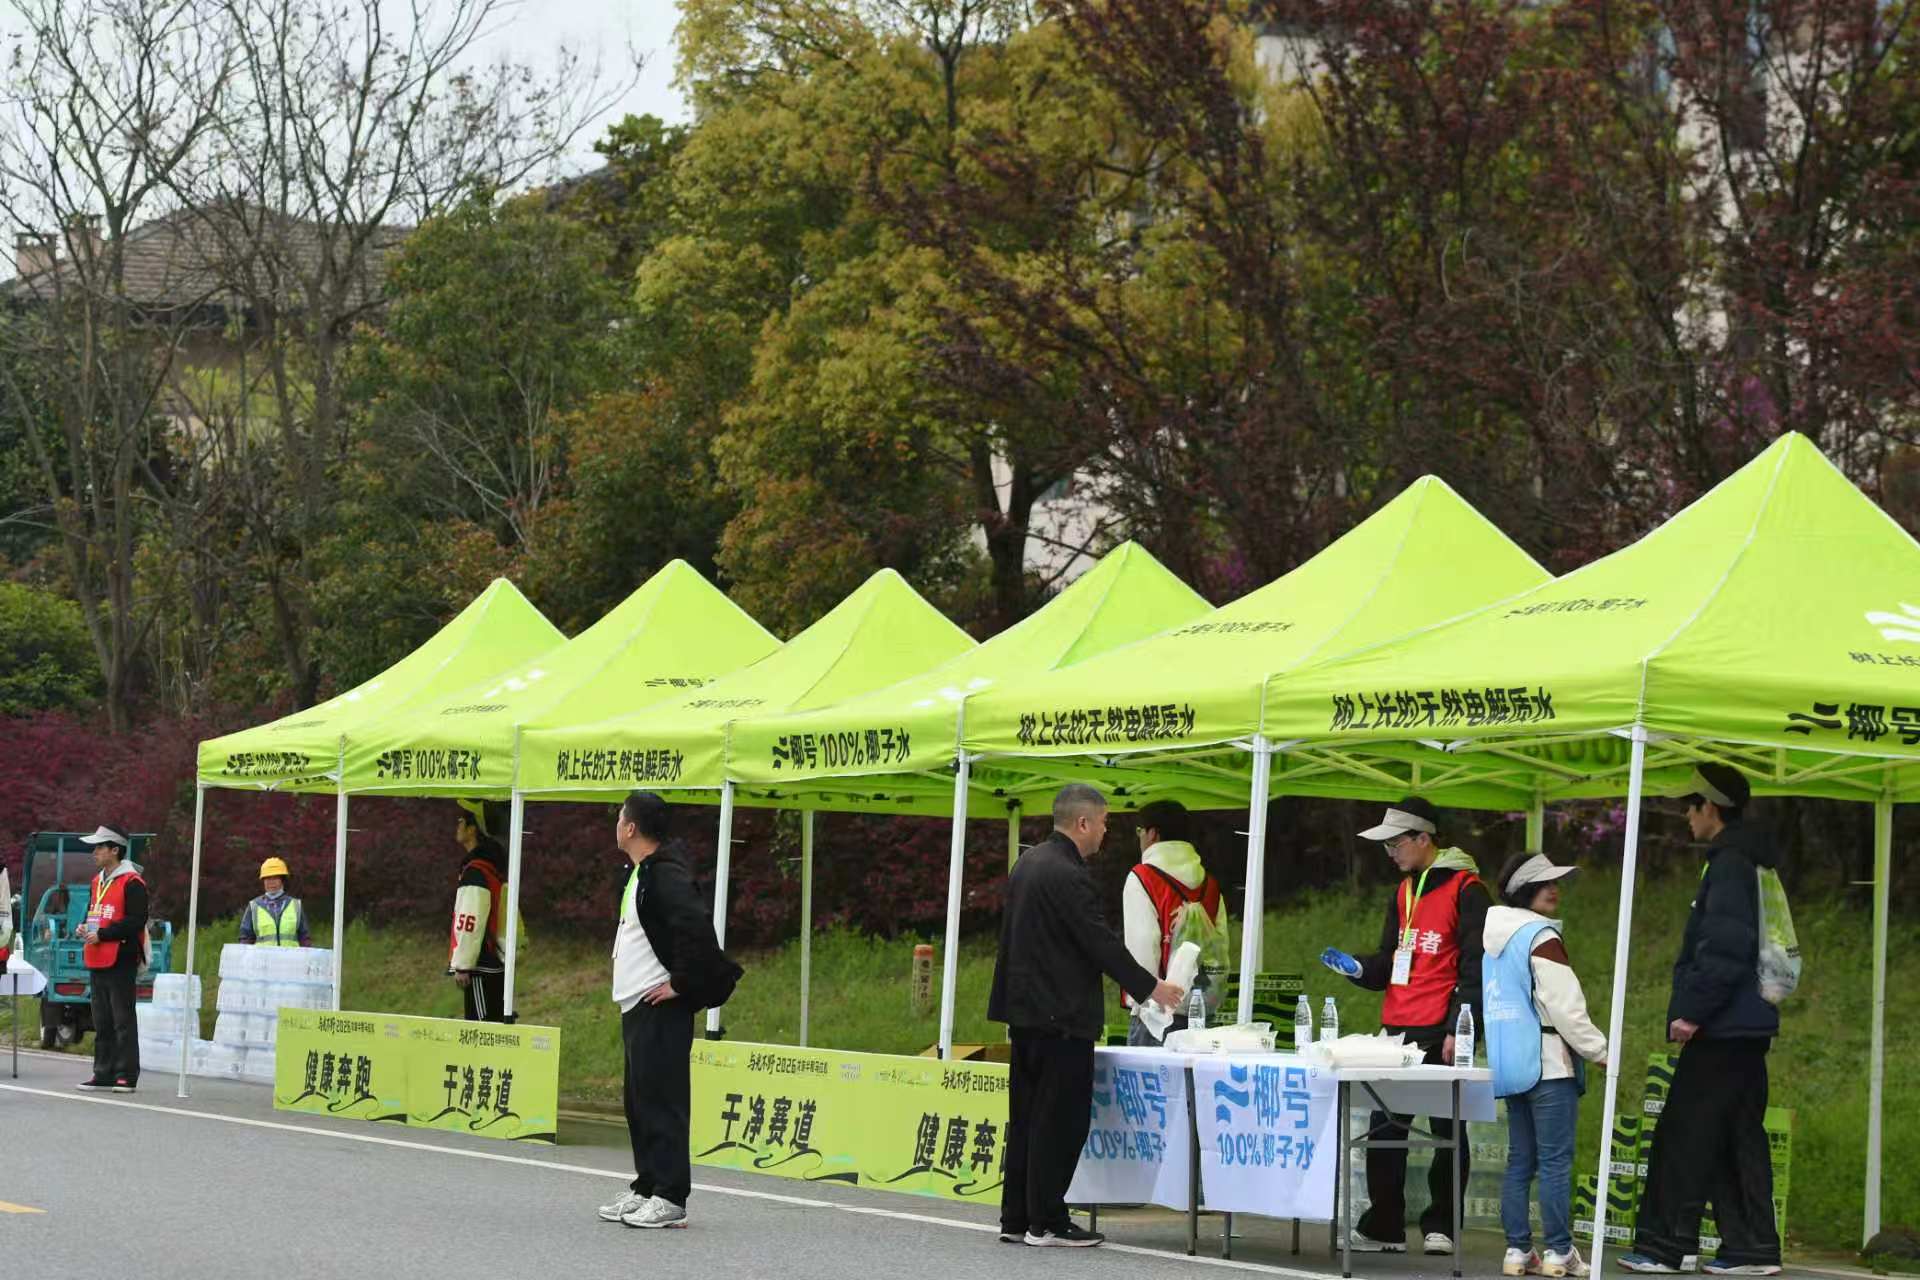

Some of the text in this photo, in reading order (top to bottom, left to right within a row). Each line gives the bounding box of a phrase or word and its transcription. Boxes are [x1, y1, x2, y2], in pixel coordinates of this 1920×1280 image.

[1017, 703, 1196, 746] 树上长的天然电解质水
[1329, 686, 1556, 731] 树上长的天然电解质水
[557, 749, 684, 782] 树上长的天然电解质水
[457, 914, 476, 933] 56
[304, 1050, 372, 1099] 健康奔跑
[443, 1065, 513, 1115] 干净赛道
[1113, 1066, 1167, 1130] 椰号
[1253, 1064, 1311, 1129] 椰号
[721, 1093, 817, 1152] 干净赛道
[1216, 1132, 1315, 1170] 100%椰子水
